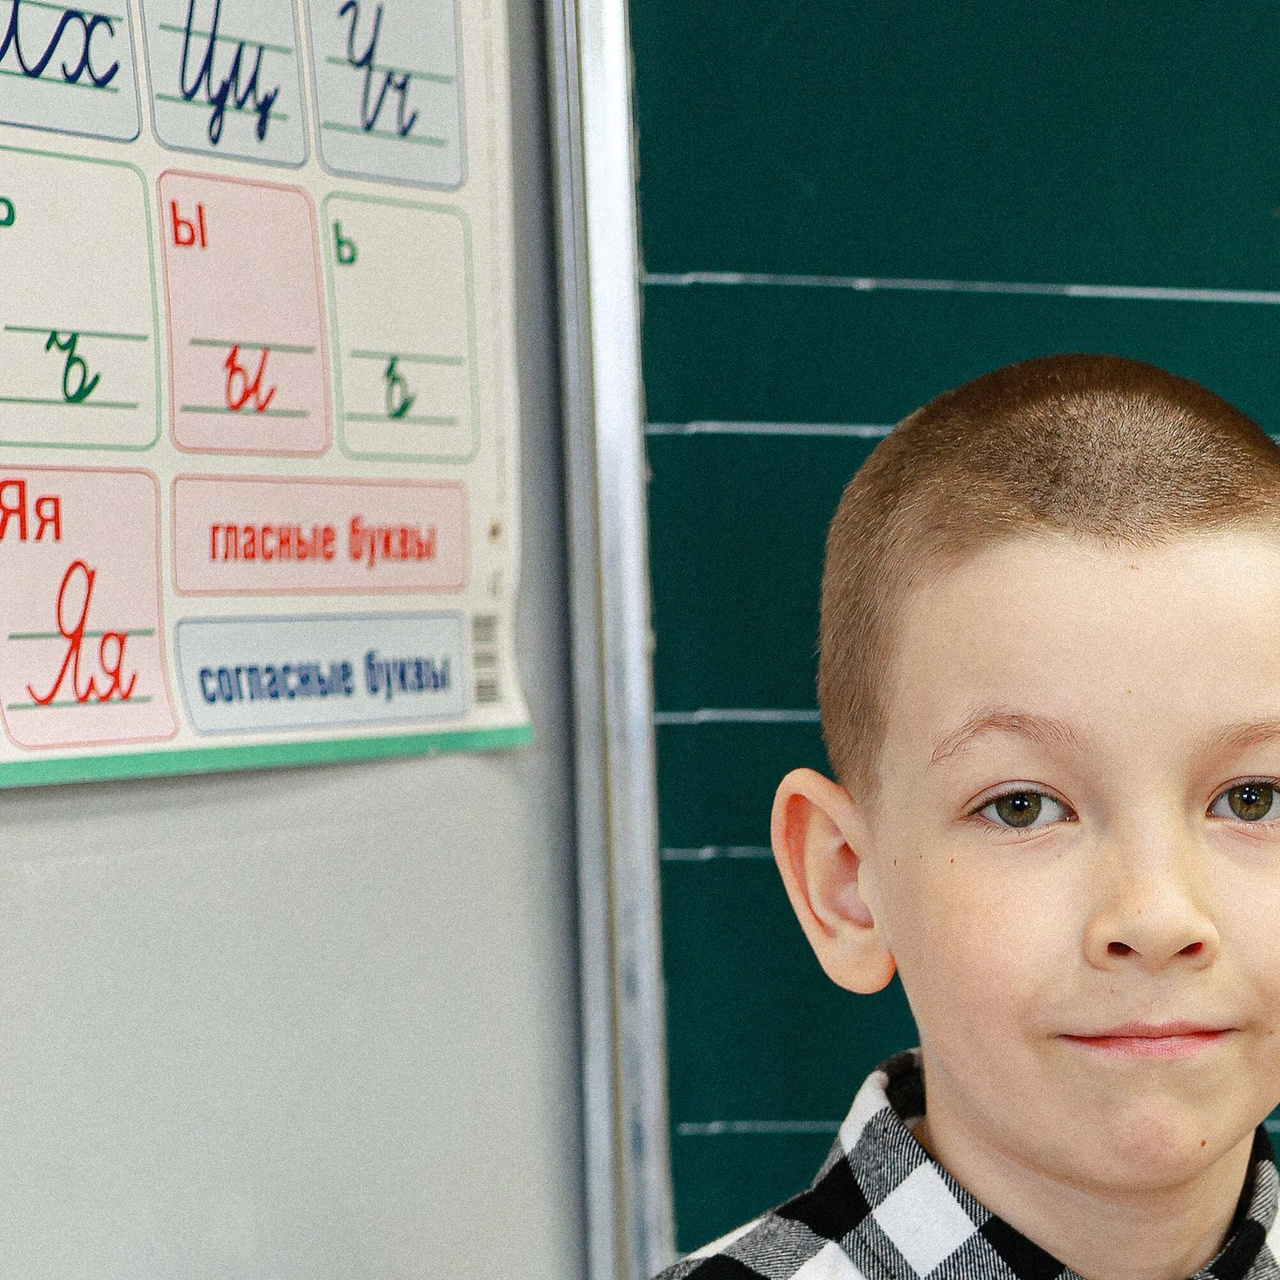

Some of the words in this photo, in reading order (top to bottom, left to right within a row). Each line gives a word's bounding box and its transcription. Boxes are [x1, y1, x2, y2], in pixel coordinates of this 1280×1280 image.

[209, 522, 337, 562] гласные
[349, 514, 437, 570] буквы
[198, 660, 353, 703] согласные
[364, 649, 450, 700] буквы
